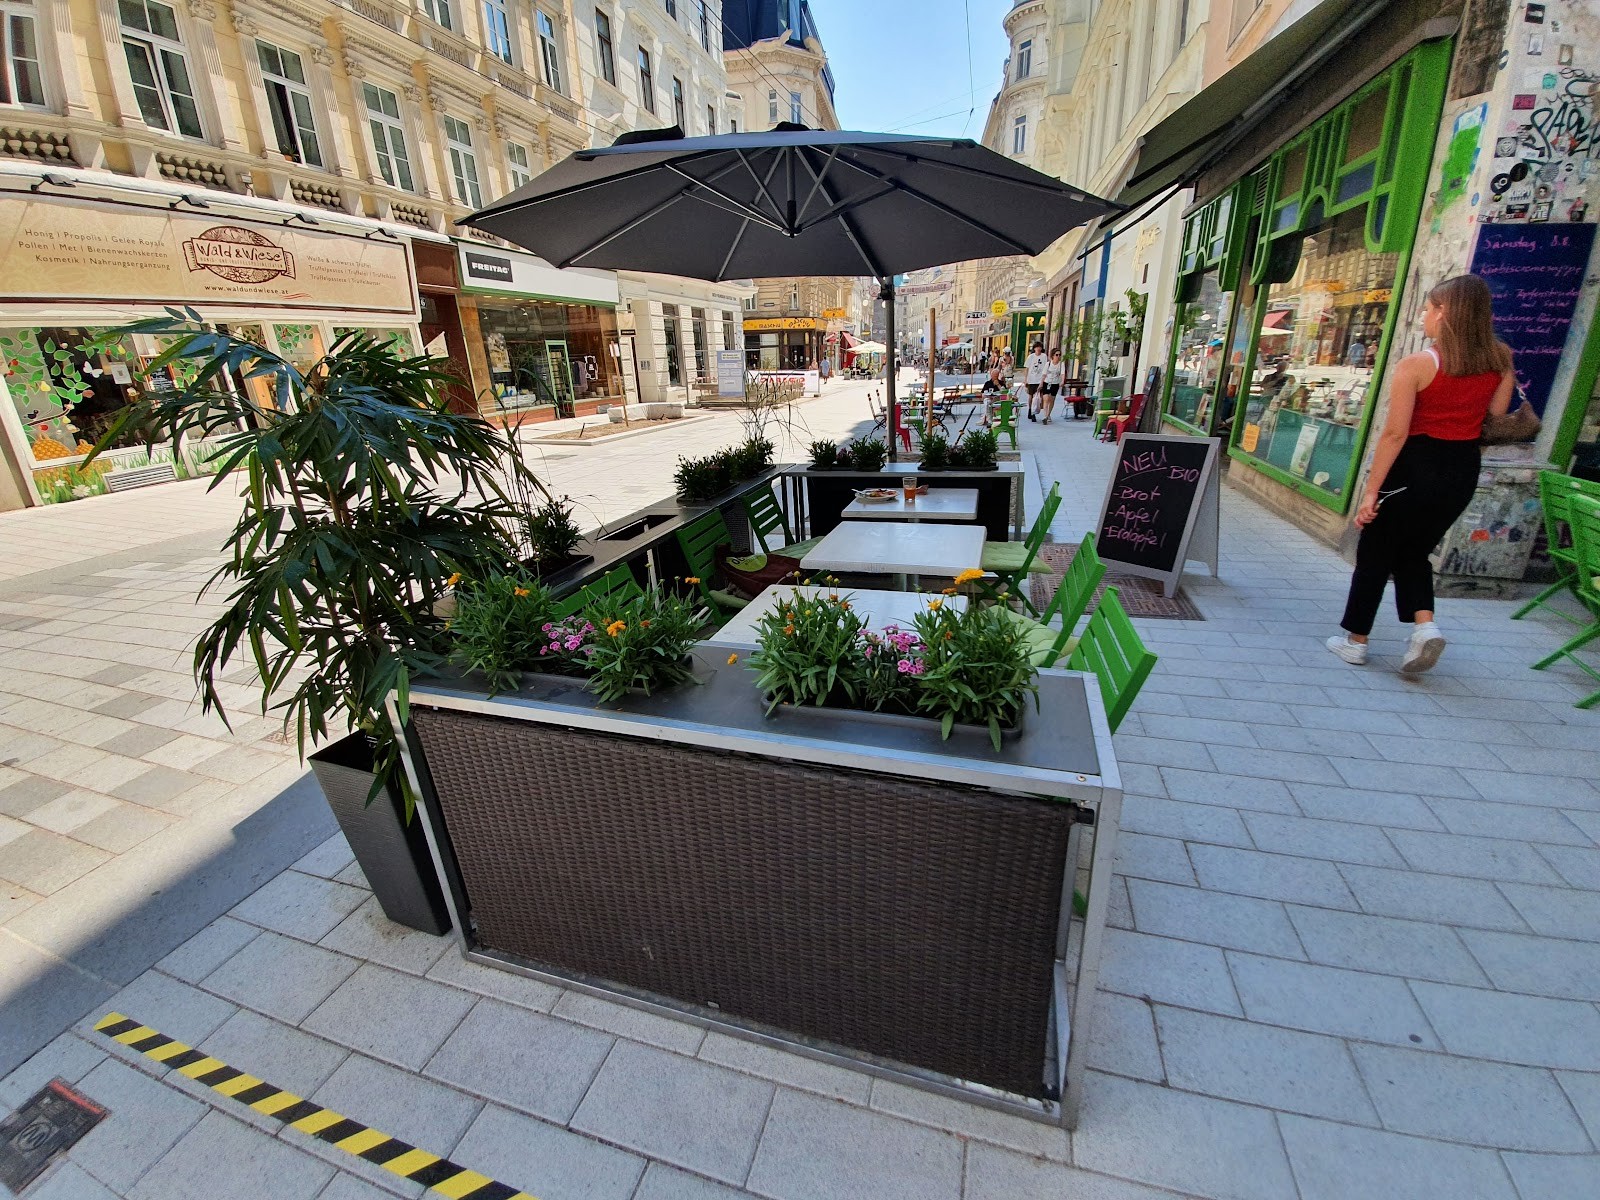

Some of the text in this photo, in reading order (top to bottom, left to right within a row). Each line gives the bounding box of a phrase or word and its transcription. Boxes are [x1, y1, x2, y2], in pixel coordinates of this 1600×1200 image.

[24, 229, 54, 239] Honig
[63, 231, 102, 242] Propolis
[139, 239, 165, 248] Royale
[18, 241, 168, 258] Pollen Met Bienenwachskerzen
[196, 242, 232, 258] Wald
[242, 247, 282, 262] Wiese
[35, 254, 80, 264] Kosmetik
[471, 262, 509, 274] FREITAG
[204, 285, 289, 295] www.waldundwiese.at
[1122, 446, 1168, 474] NEU
[1168, 465, 1200, 483] BIO
